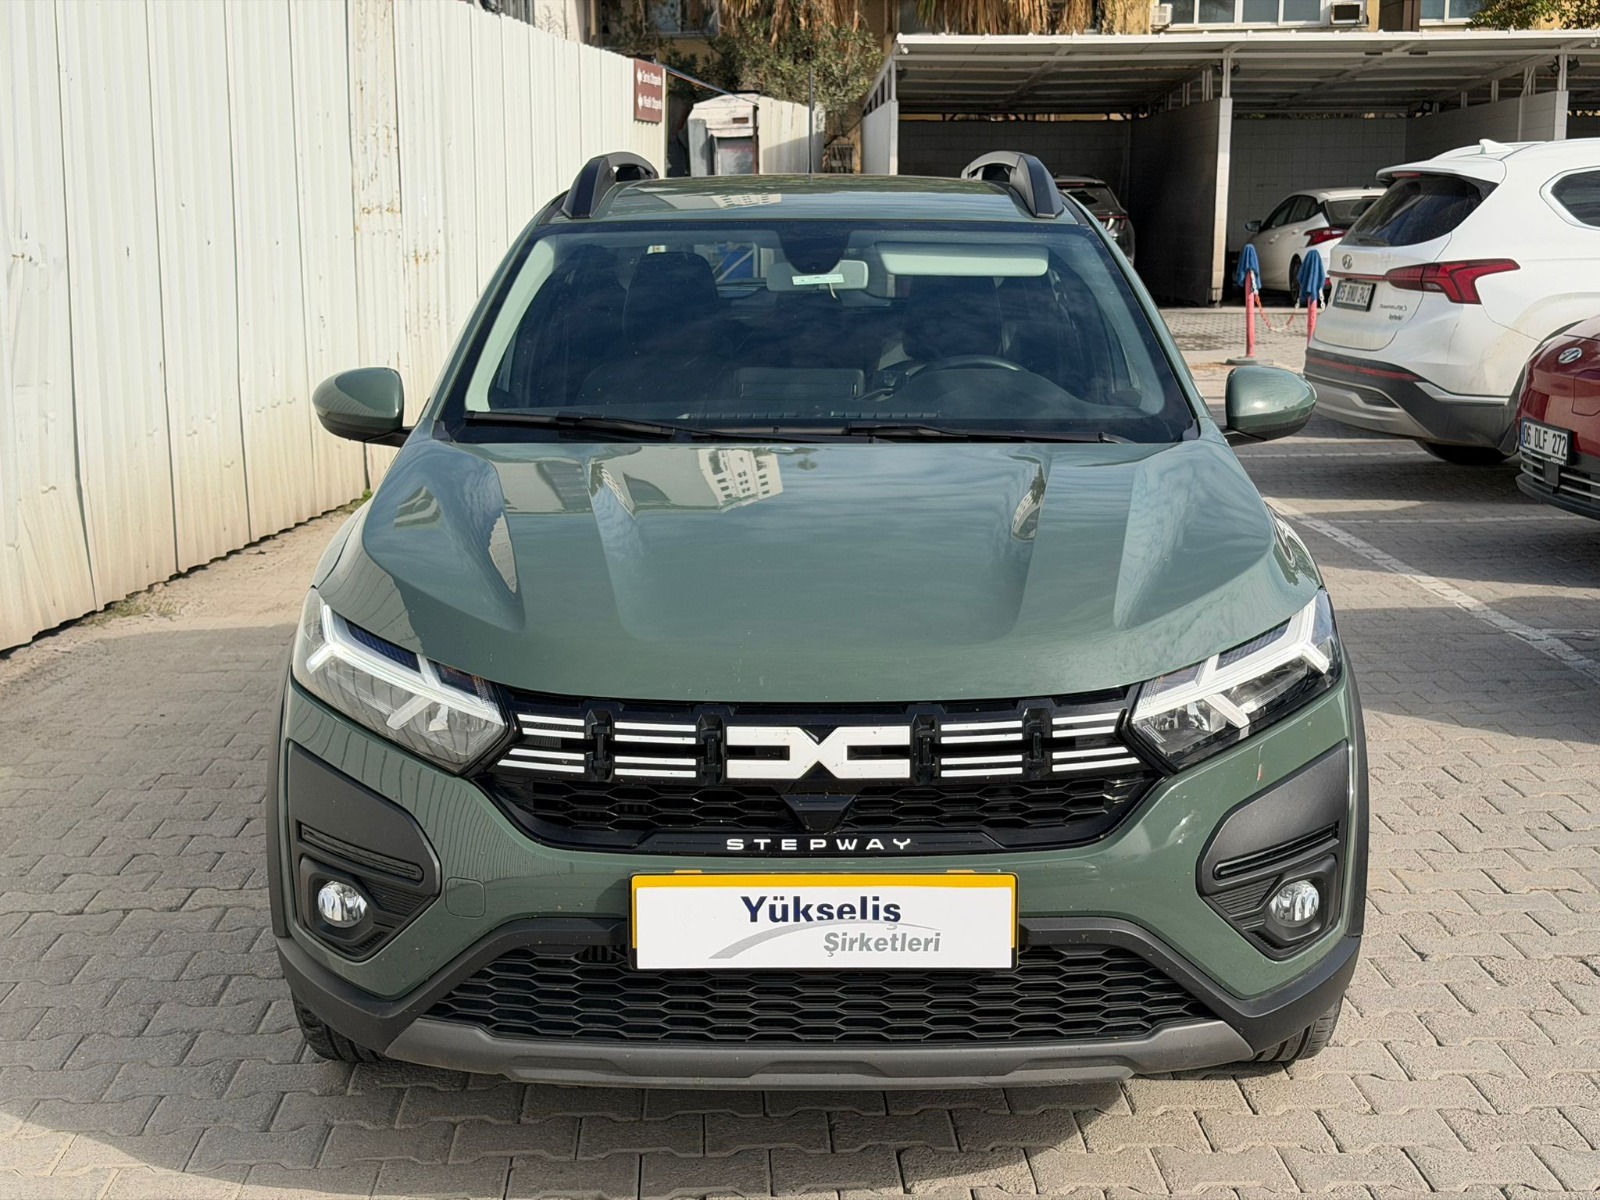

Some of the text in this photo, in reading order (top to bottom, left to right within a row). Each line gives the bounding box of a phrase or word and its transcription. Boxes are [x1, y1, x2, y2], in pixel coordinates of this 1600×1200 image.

[1524, 424, 1532, 446] 06
[1534, 427, 1548, 450] DLF
[1551, 433, 1567, 457] 272
[726, 838, 911, 851] STEPWAY
[740, 895, 902, 930] Yükseliş
[823, 932, 942, 957] Şirketleri
